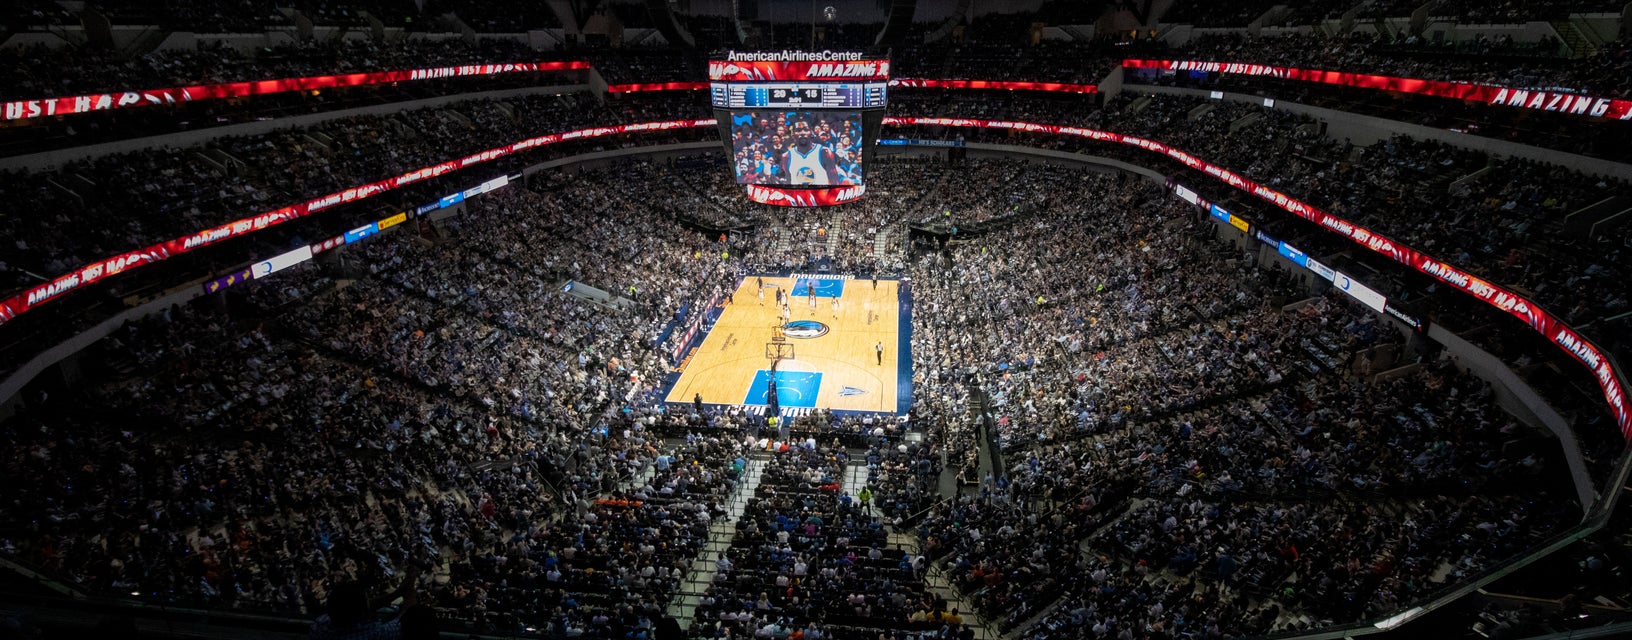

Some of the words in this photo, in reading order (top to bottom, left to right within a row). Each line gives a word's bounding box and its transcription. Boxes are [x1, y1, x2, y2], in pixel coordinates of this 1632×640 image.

[728, 50, 863, 61] AmericanAirlinesCenter
[806, 64, 877, 77] AMAZING
[0, 99, 59, 120] UST
[1492, 88, 1611, 117] AMAZING
[27, 275, 80, 306] AMAZING
[1422, 260, 1470, 288] AMAZING
[1467, 280, 1497, 299] JUST
[1556, 330, 1601, 369] AMAZING
